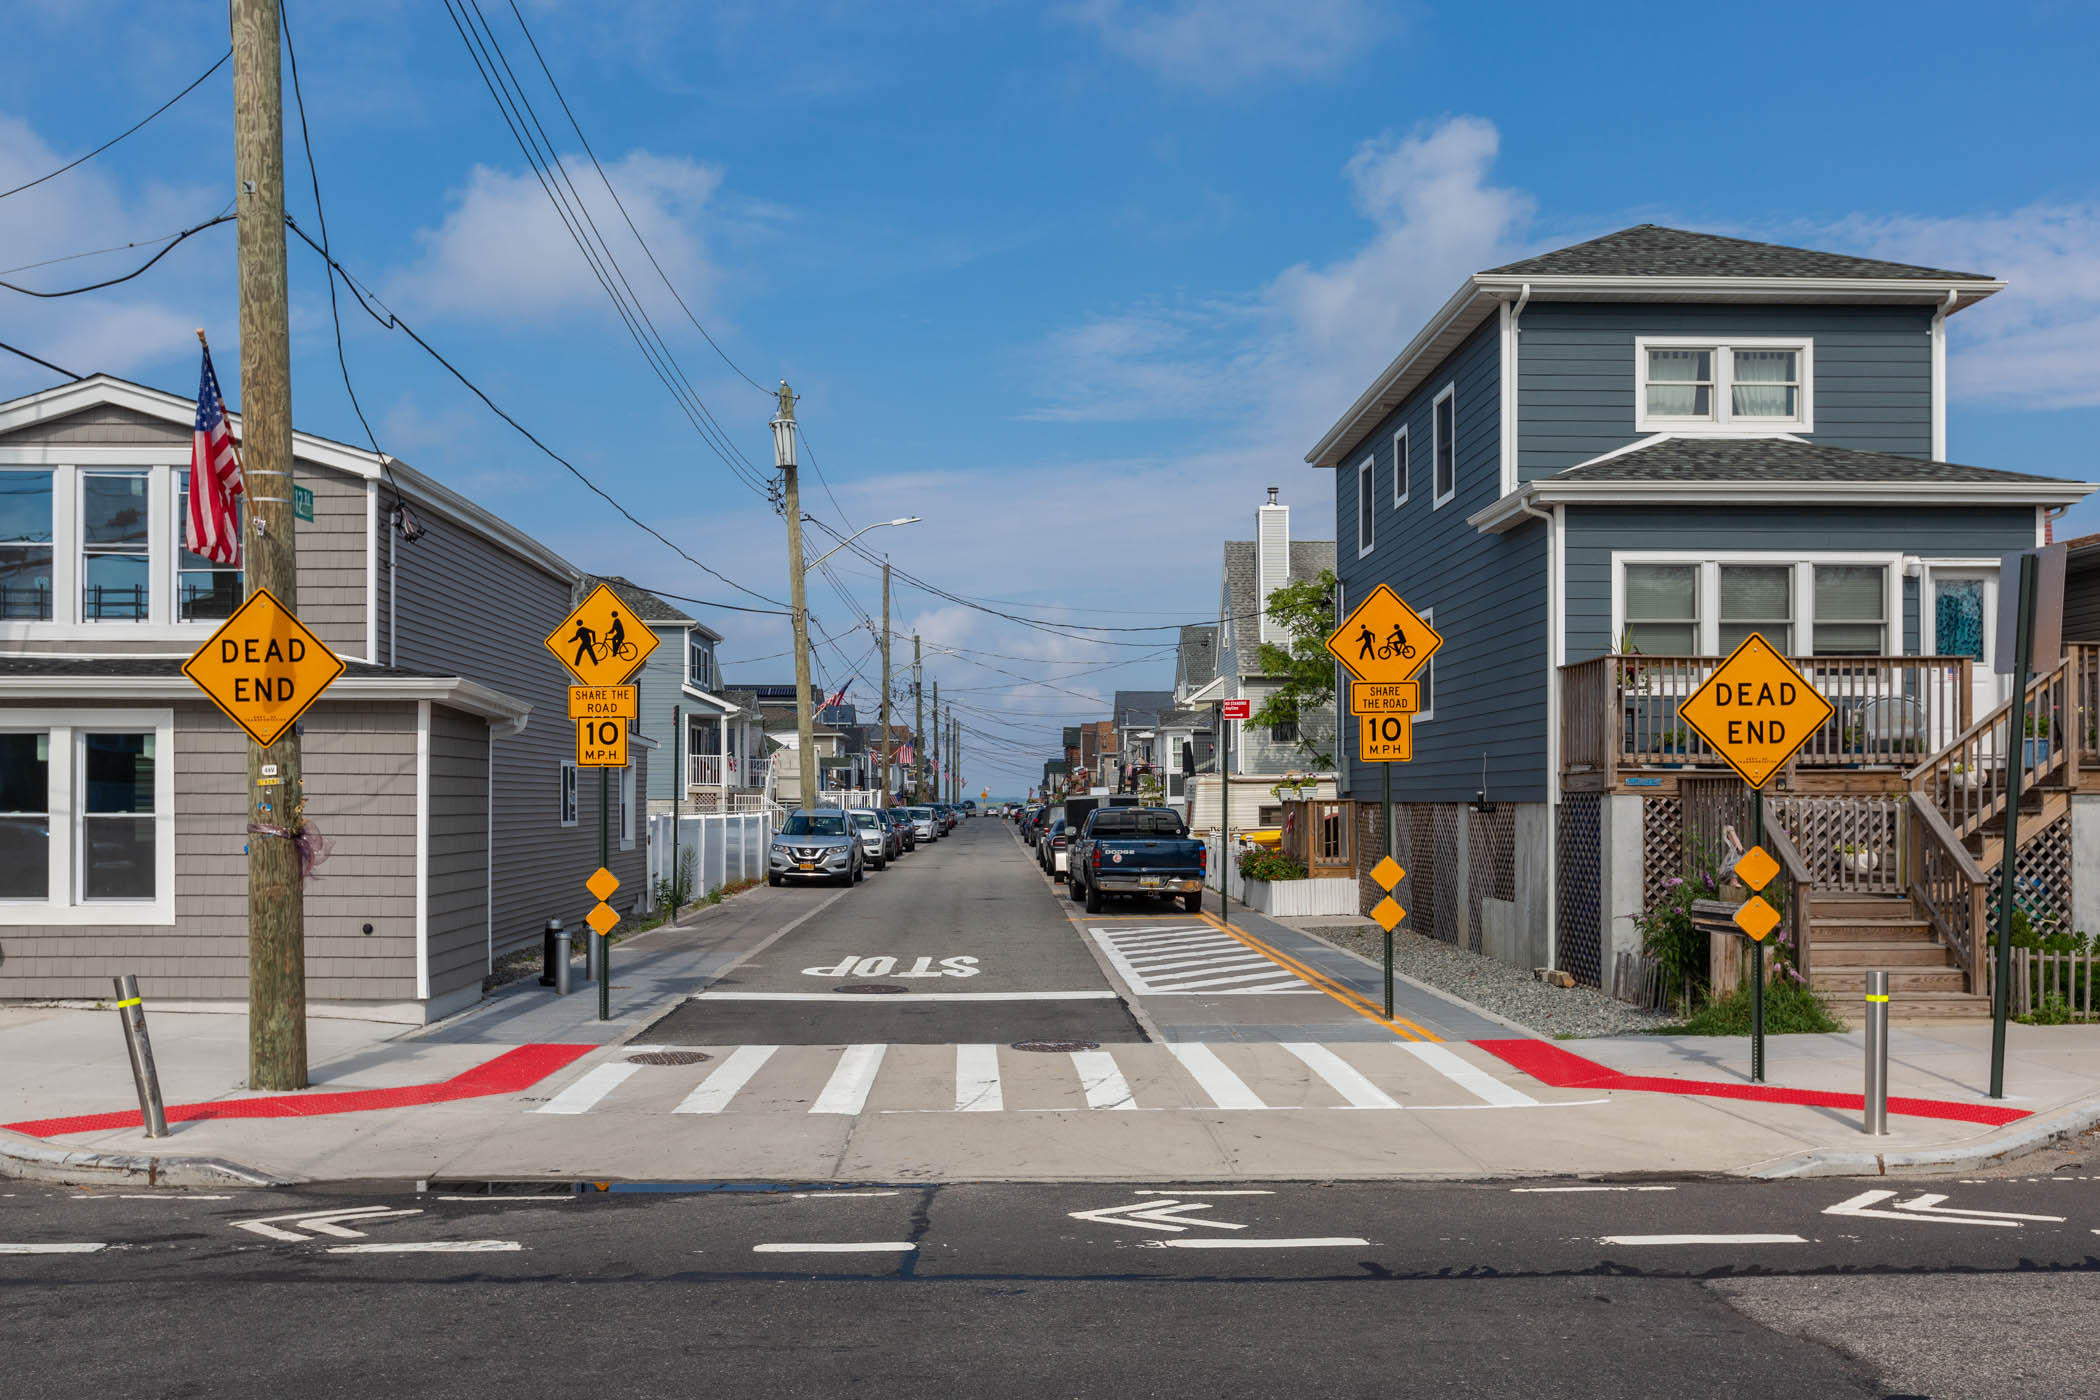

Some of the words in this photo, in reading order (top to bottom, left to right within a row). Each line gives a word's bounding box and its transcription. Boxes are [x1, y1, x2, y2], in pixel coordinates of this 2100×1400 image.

[222, 639, 306, 663] DEAD
[234, 677, 295, 702] END
[575, 690, 607, 700] SHARE
[612, 690, 629, 700] THE
[1370, 686, 1400, 696] SHARE
[1716, 682, 1796, 706] DEAD
[587, 703, 618, 713] ROAD
[1363, 699, 1380, 709] THE
[1383, 699, 1408, 708] ROAD
[586, 721, 618, 745] 10
[1369, 717, 1401, 742] 10
[1728, 720, 1785, 744] END
[801, 955, 981, 978] STOP
